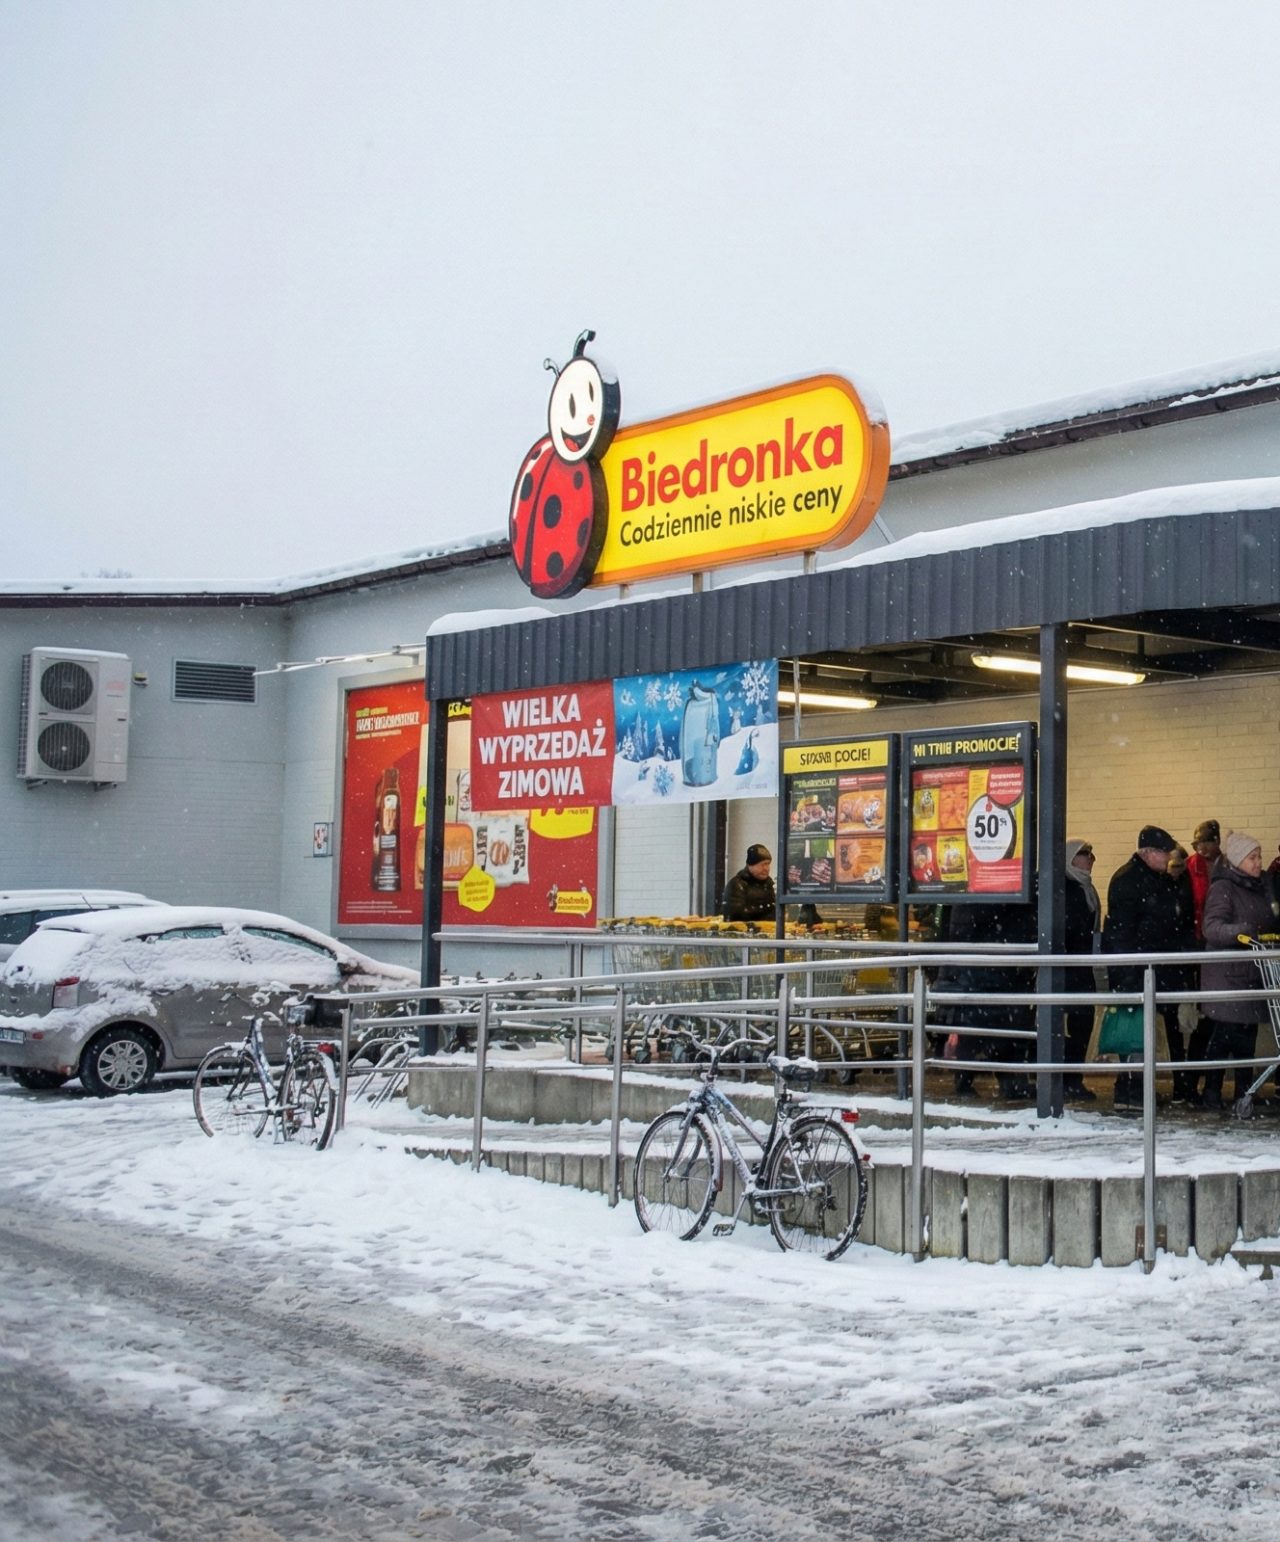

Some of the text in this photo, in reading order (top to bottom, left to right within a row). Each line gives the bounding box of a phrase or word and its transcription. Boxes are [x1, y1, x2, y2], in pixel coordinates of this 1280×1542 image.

[621, 417, 843, 512] Biedronka
[620, 484, 843, 546] Codziennie niskie ceny
[502, 693, 581, 728] WIELKA
[478, 718, 607, 764] WYPRZEDAŻ
[498, 766, 585, 798] ZIMOWA
[974, 815, 999, 838] 50
